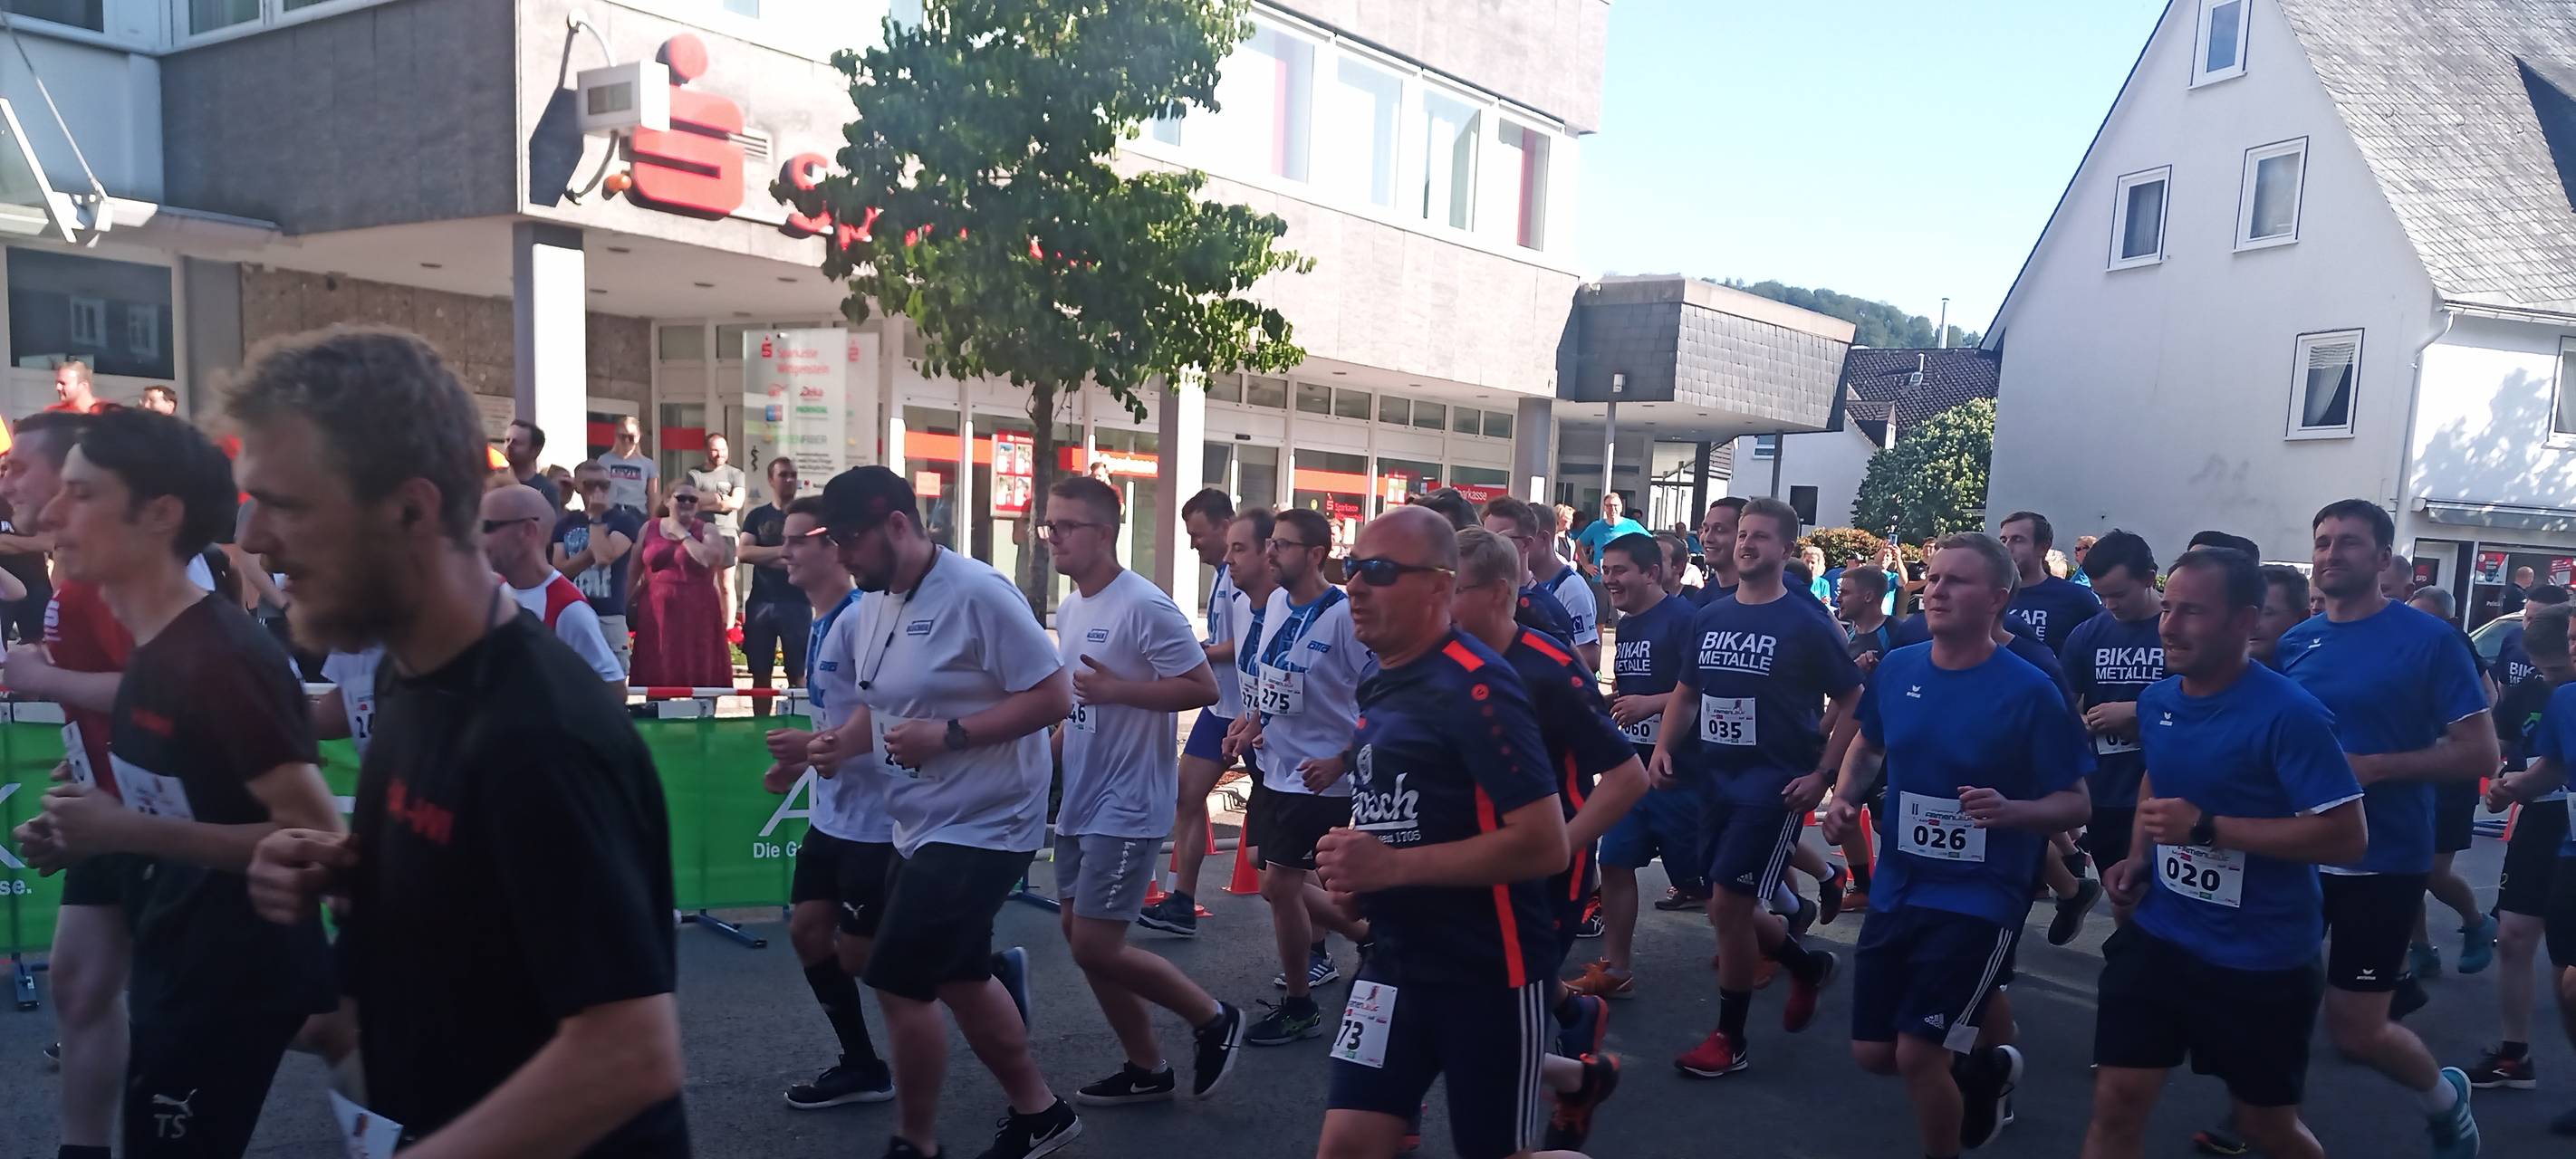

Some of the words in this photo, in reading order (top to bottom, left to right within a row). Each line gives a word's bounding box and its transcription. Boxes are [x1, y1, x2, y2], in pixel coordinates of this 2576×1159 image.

[1616, 640, 1651, 659] BIKAR
[1702, 632, 1776, 656] BIKAR
[1616, 659, 1650, 672] ETALLE
[1698, 651, 1773, 671] METALLE
[2095, 647, 2165, 666] BIKAR
[2095, 666, 2163, 680] METALLE
[1262, 688, 1290, 710] 275
[1709, 720, 1742, 739] 035
[1395, 830, 1421, 843] 1705
[1913, 825, 1966, 850] 026
[754, 842, 780, 858] Die
[786, 841, 803, 857] G
[2167, 857, 2220, 892] 020
[153, 1114, 187, 1138] TS
